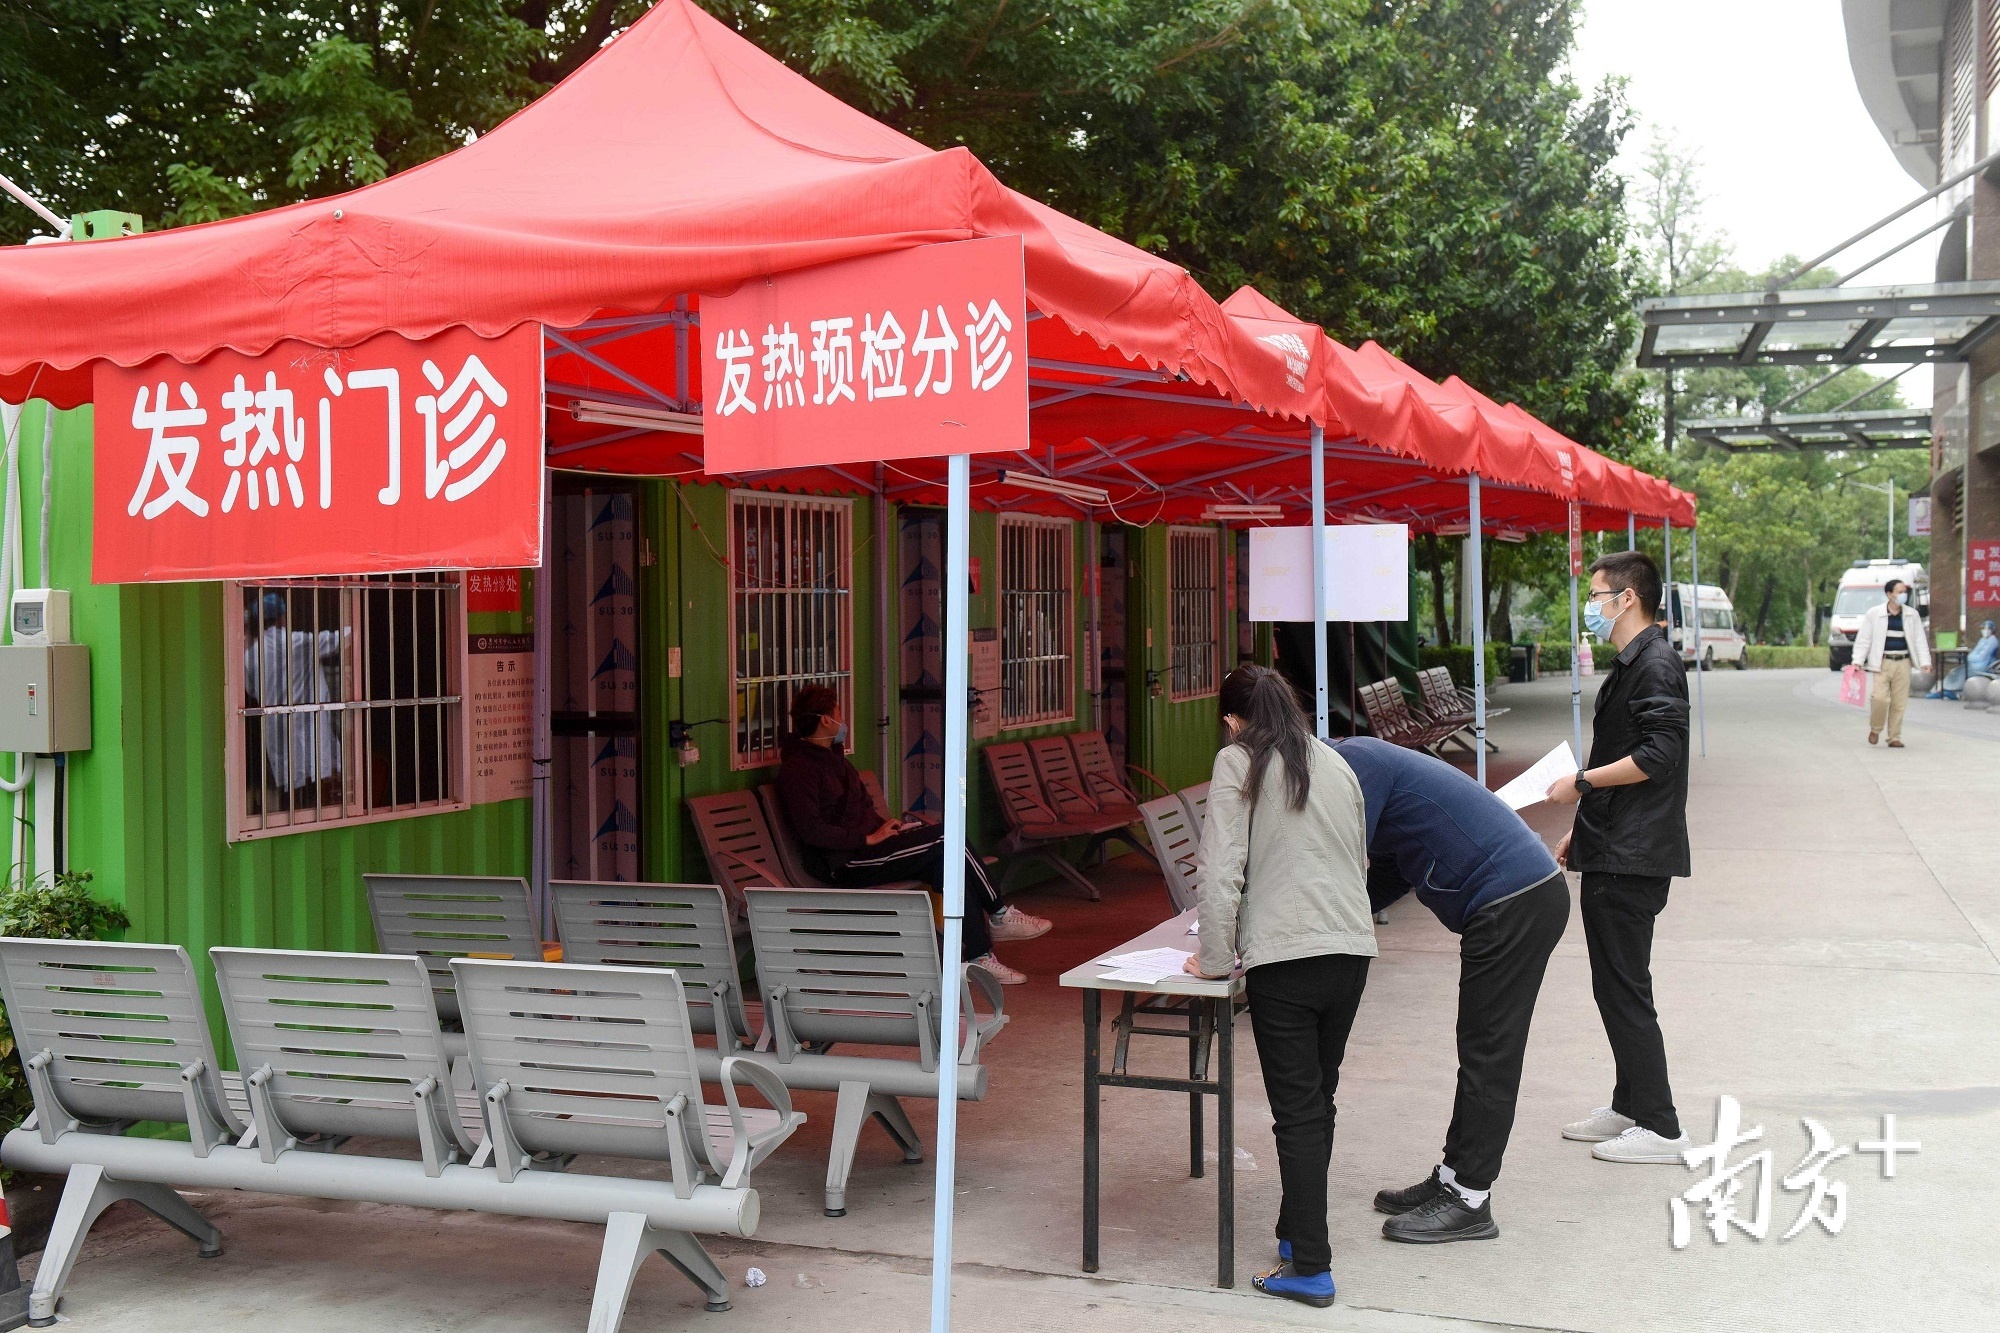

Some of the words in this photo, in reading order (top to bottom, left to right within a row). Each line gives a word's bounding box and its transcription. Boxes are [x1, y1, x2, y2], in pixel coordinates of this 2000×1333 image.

[715, 298, 1013, 417] 发热预检分诊
[127, 354, 508, 520] 发热门诊
[1974, 549, 1985, 602] 取药点
[497, 661, 515, 672] 告示
